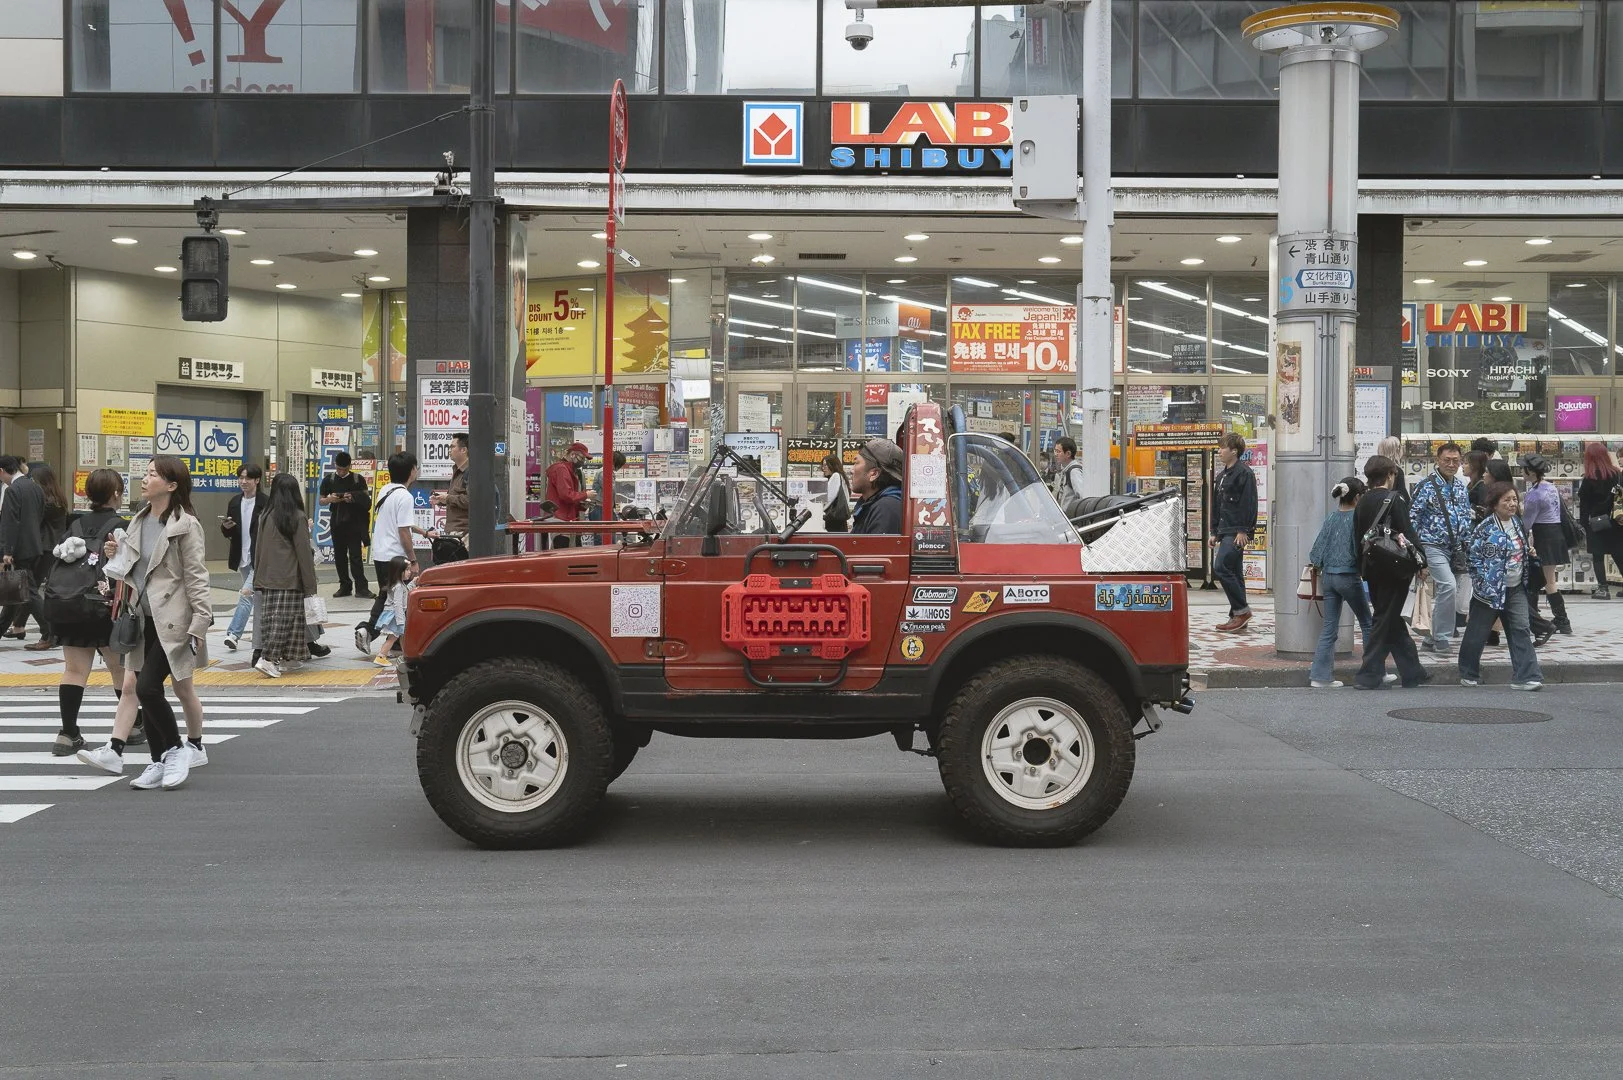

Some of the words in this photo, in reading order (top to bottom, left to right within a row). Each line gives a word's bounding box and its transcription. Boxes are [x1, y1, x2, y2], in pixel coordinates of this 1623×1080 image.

[830, 147, 1013, 169] SHIBUY
[1305, 239, 1349, 251] 渋谷駅
[1305, 253, 1349, 265] 青山通り
[1305, 272, 1349, 281] 文化村通り
[1305, 292, 1349, 304] 山手通り
[529, 304, 541, 312] DIS
[554, 290, 569, 321] 5
[529, 313, 552, 322] COUNT
[855, 317, 890, 326] SotBank
[1024, 312, 1060, 322] Japan!
[1425, 303, 1527, 332] LABI
[952, 323, 981, 339] TAX
[985, 323, 1020, 340] FREE
[1425, 334, 1525, 347] SHIBUYA
[953, 343, 986, 359] 免税
[994, 343, 1020, 359] 면세
[1021, 342, 1057, 370] 10
[196, 370, 241, 380] エレベーター
[1426, 369, 1471, 378] SONY
[1490, 365, 1535, 374] HITACHI
[430, 381, 469, 393] 営業時
[1422, 401, 1474, 410] SHARP
[1491, 401, 1533, 410] Canon
[1558, 401, 1592, 411] Rakuten
[424, 410, 450, 425] 10:00
[461, 410, 470, 425] 2
[788, 440, 837, 448] スマートフォン
[424, 444, 449, 460] 12:00
[917, 588, 947, 599] Clubman
[1098, 589, 1171, 607] dj.jimny
